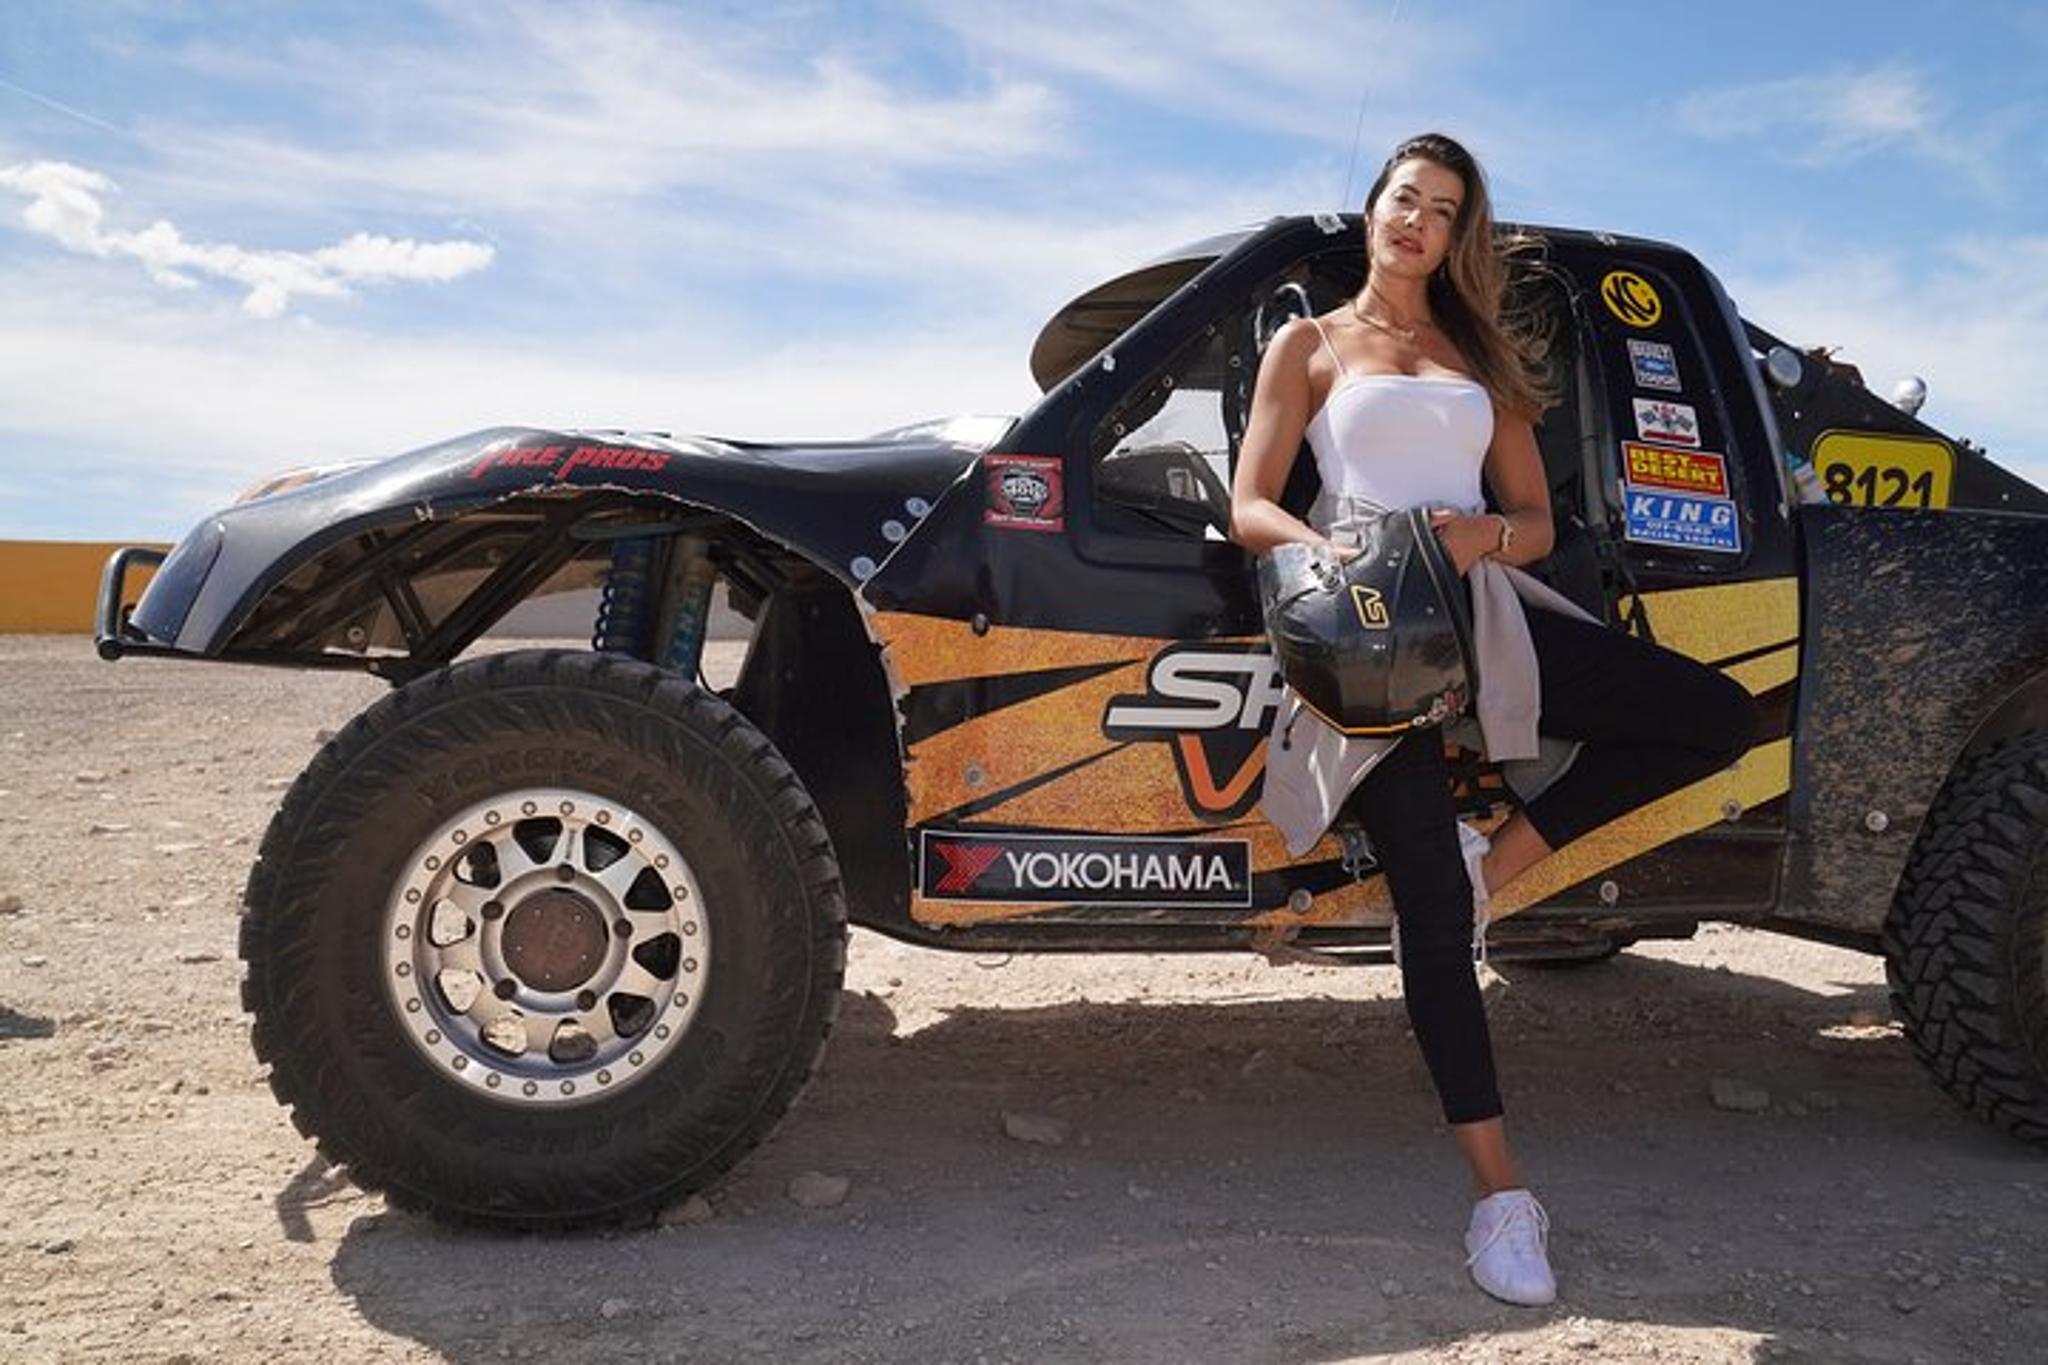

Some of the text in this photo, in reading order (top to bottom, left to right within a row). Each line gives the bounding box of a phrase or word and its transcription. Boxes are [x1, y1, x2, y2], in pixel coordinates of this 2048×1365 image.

[1606, 275, 1656, 321] KC
[556, 446, 672, 479] PROS
[1825, 463, 1932, 507] 8121
[1632, 496, 1731, 526] KING
[1005, 851, 1233, 889] YOKOHAMA
